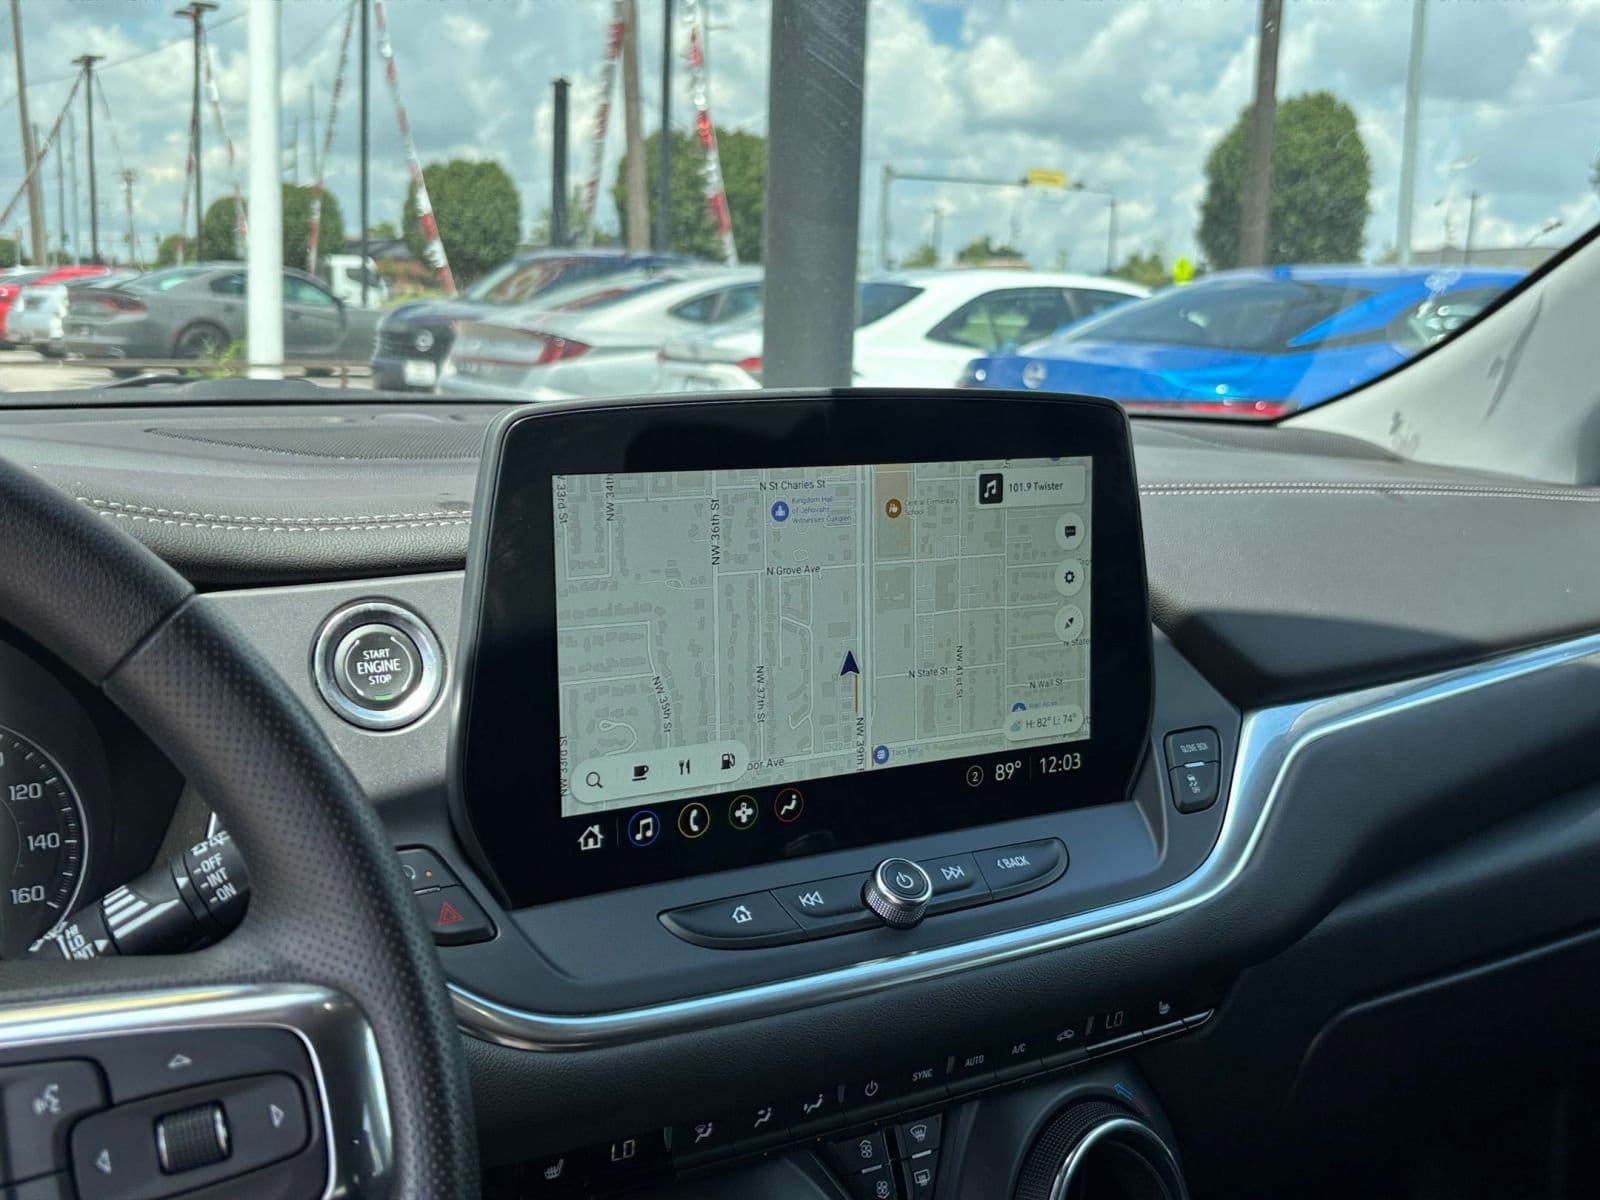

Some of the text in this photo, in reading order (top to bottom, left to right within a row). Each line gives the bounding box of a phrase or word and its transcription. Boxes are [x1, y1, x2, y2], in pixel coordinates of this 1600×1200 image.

[760, 479, 826, 490] N St Charles St
[1008, 481, 1063, 493] 101.9 Twister
[559, 512, 568, 524] St
[606, 502, 615, 521] NW
[711, 499, 720, 565] NW 36th St
[767, 565, 820, 576] N Grove Ave
[362, 648, 391, 659] START
[956, 645, 963, 662] NW
[356, 658, 401, 675] ENGINE
[908, 667, 948, 678] N State St
[368, 674, 392, 685] STOP
[1029, 681, 1036, 689] N
[1055, 678, 1064, 686] St
[756, 665, 765, 724] NW 37th St
[956, 689, 963, 698] St
[652, 676, 672, 733] NW 35th St
[856, 717, 864, 736] NW
[856, 740, 864, 765] 39th
[766, 758, 785, 768] Ave
[1040, 753, 1081, 774] 12:03
[9, 782, 42, 801] 120
[27, 832, 60, 851] 140
[1002, 855, 1031, 869] BACK
[206, 866, 228, 887] INT
[10, 885, 45, 905] 160
[216, 882, 237, 901] ON
[1011, 1043, 1026, 1056] A/C
[964, 1054, 985, 1068] AUTO
[912, 1068, 933, 1082] SYNC
[611, 1139, 636, 1162] LO
